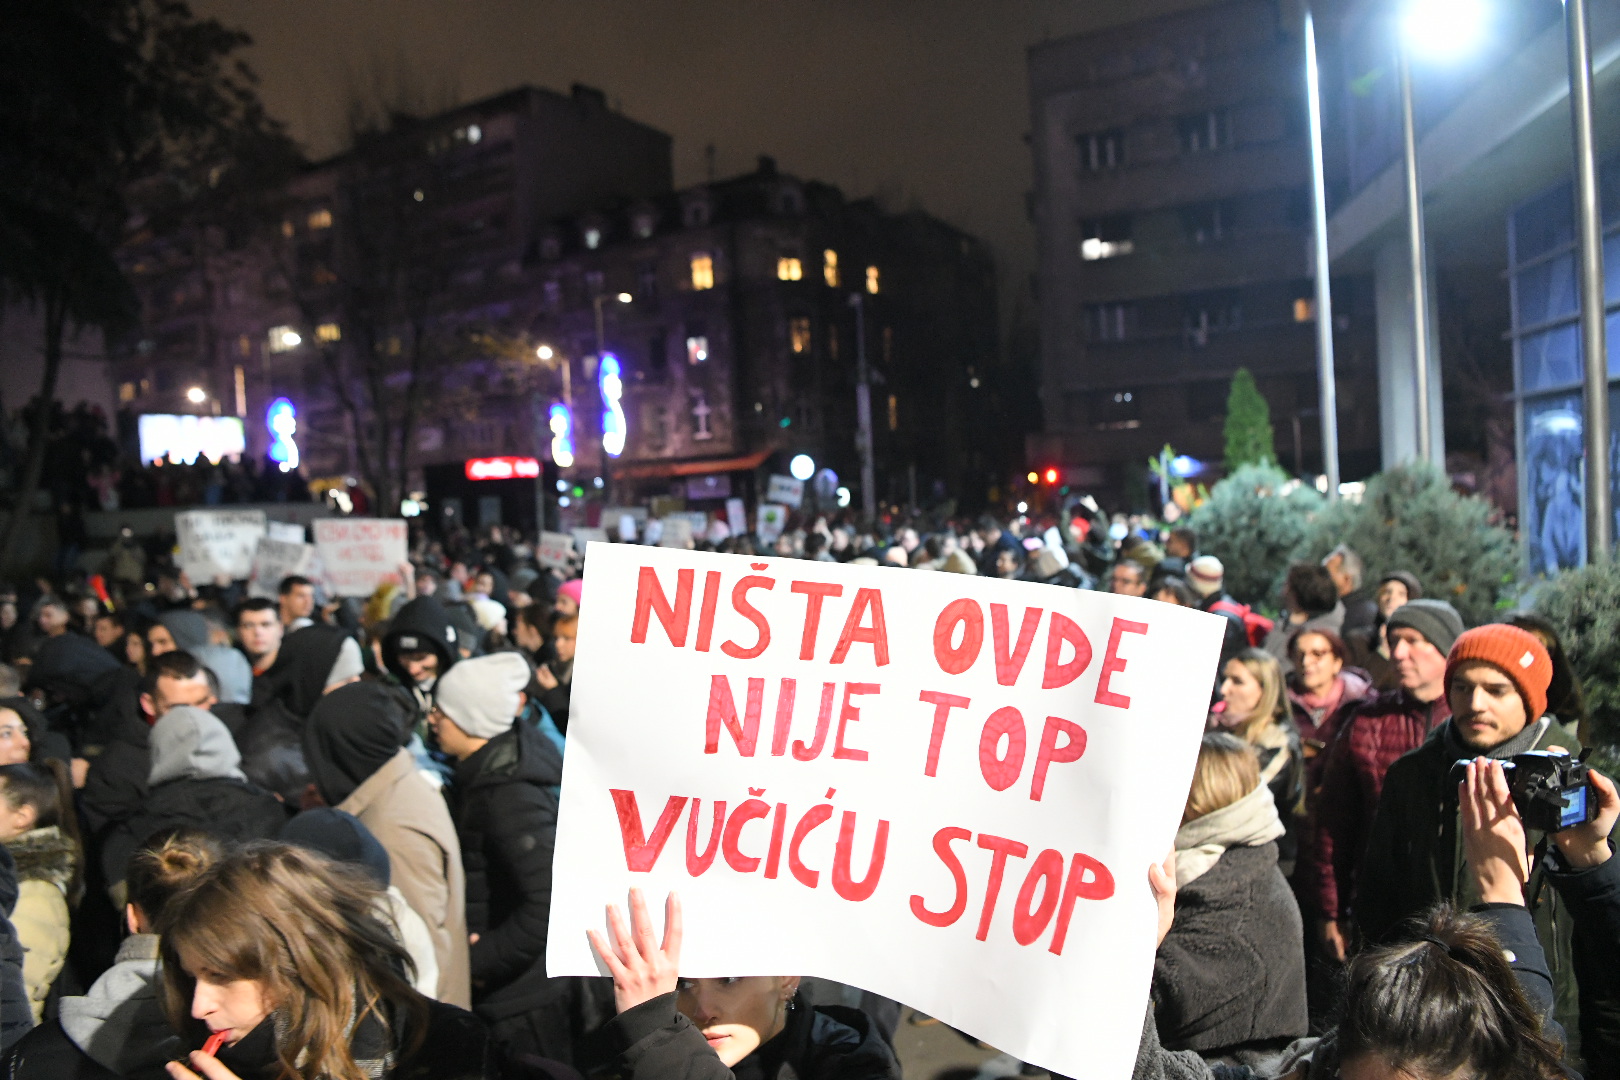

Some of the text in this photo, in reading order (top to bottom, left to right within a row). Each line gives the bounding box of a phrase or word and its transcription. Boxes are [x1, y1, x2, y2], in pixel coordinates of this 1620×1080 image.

[630, 564, 1148, 709] NIŠTA OVDE
[704, 675, 1087, 801] NIJE TOP
[609, 787, 1115, 956] VUČIĆU STOP
